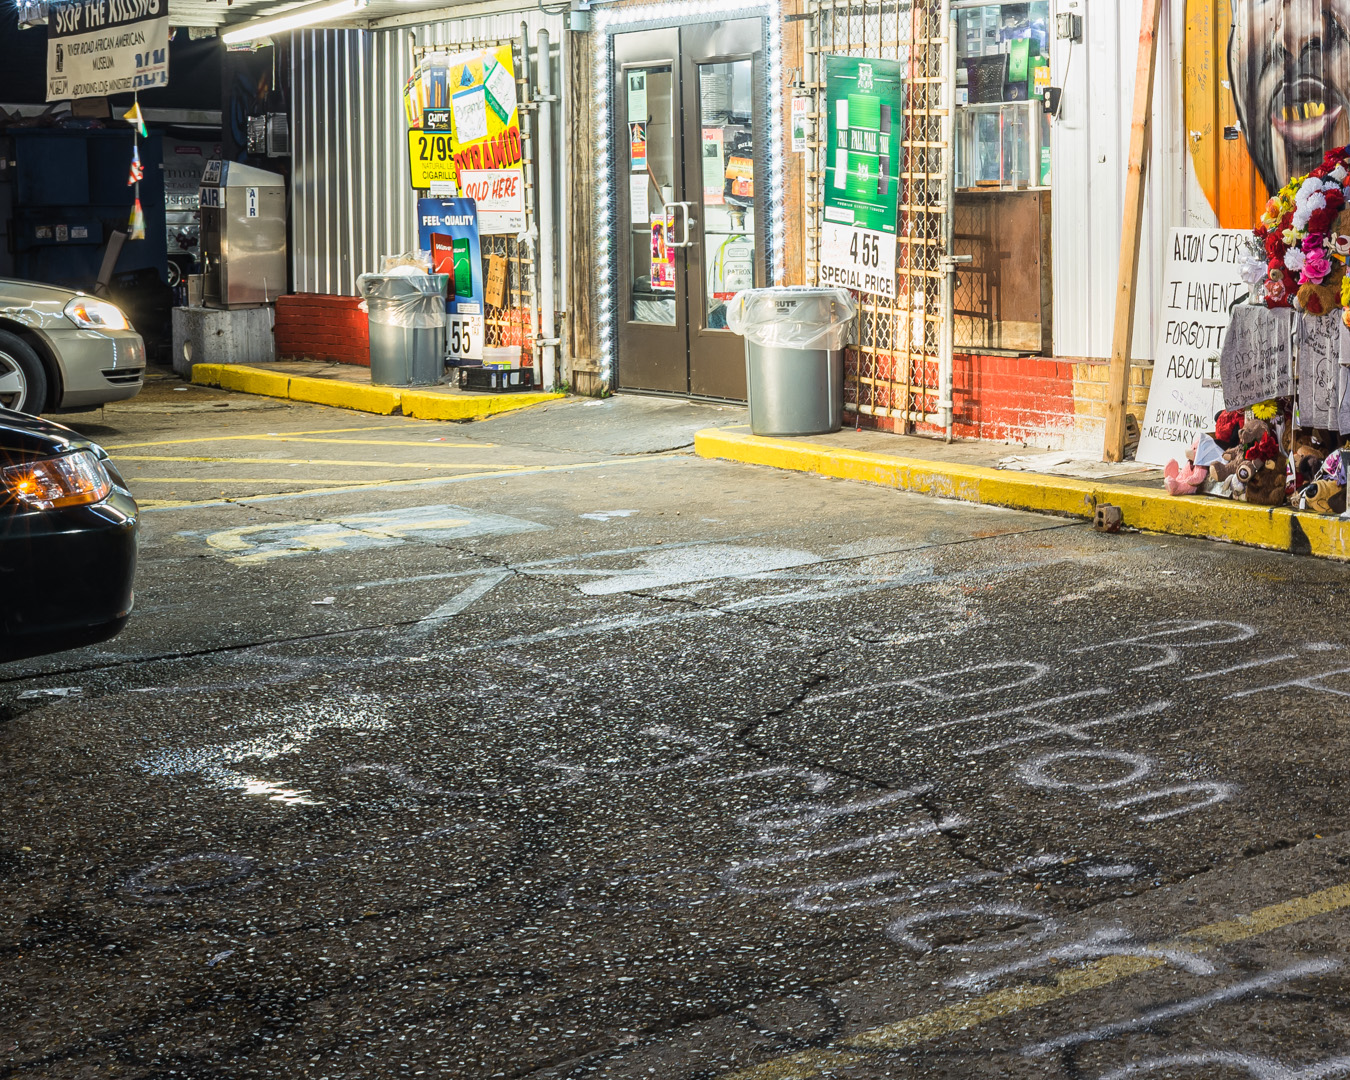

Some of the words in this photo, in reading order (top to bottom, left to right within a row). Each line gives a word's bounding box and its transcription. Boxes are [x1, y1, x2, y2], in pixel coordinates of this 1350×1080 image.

[56, 2, 82, 34] STOP
[67, 42, 80, 56] RIVER
[80, 41, 94, 54] ROAD
[95, 37, 115, 52] AFRICAN
[115, 31, 145, 49] AMERICAN
[93, 56, 115, 71] MUSEUM
[428, 113, 449, 130] game
[851, 130, 863, 151] PALL
[864, 131, 877, 153] MALL
[210, 162, 220, 171] AIR
[422, 162, 447, 170] NATURAL
[453, 126, 521, 190] PYRAMID
[201, 188, 219, 206] AIR
[465, 181, 489, 201] SOLD
[492, 177, 518, 200] HERE
[422, 216, 441, 226] FEEL
[445, 216, 474, 226] QUALITY
[850, 232, 880, 268] 4.55
[1174, 232, 1205, 262] ALTON
[1207, 233, 1244, 263] STER
[821, 265, 862, 288] SPECIAL
[865, 274, 894, 295] PRICE!
[1168, 281, 1183, 309] I
[1186, 282, 1242, 313] HAVEN'T
[444, 321, 471, 355] .55
[1167, 355, 1218, 380] ABOUT
[1156, 409, 1166, 423] BY
[1167, 410, 1181, 425] ANY
[1183, 411, 1209, 430] MEANS
[1147, 426, 1196, 444] NECESSARY
